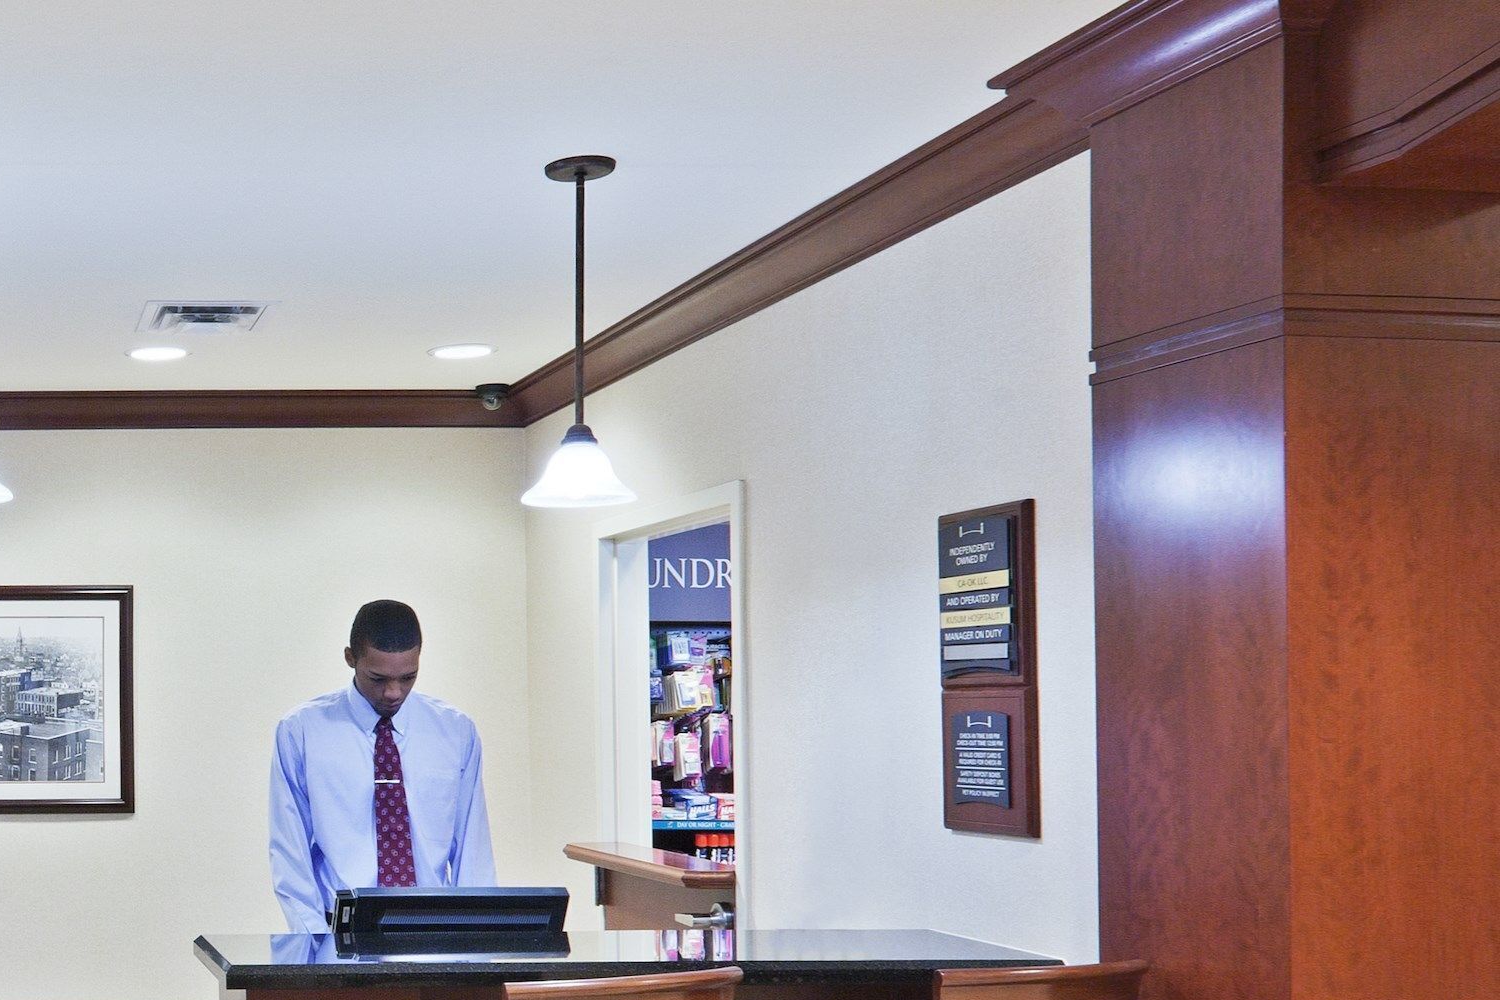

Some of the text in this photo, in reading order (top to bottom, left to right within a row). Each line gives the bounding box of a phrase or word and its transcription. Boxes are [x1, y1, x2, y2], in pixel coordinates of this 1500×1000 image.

[949, 541, 995, 557] INDEPENDENTLY
[956, 553, 988, 566] OWNED BY
[946, 592, 1000, 606] AND OPERATED BY
[967, 611, 1005, 623] HOSPITALITY
[944, 628, 1003, 642] MANAGER ON DUTY
[690, 804, 716, 813] HALLS
